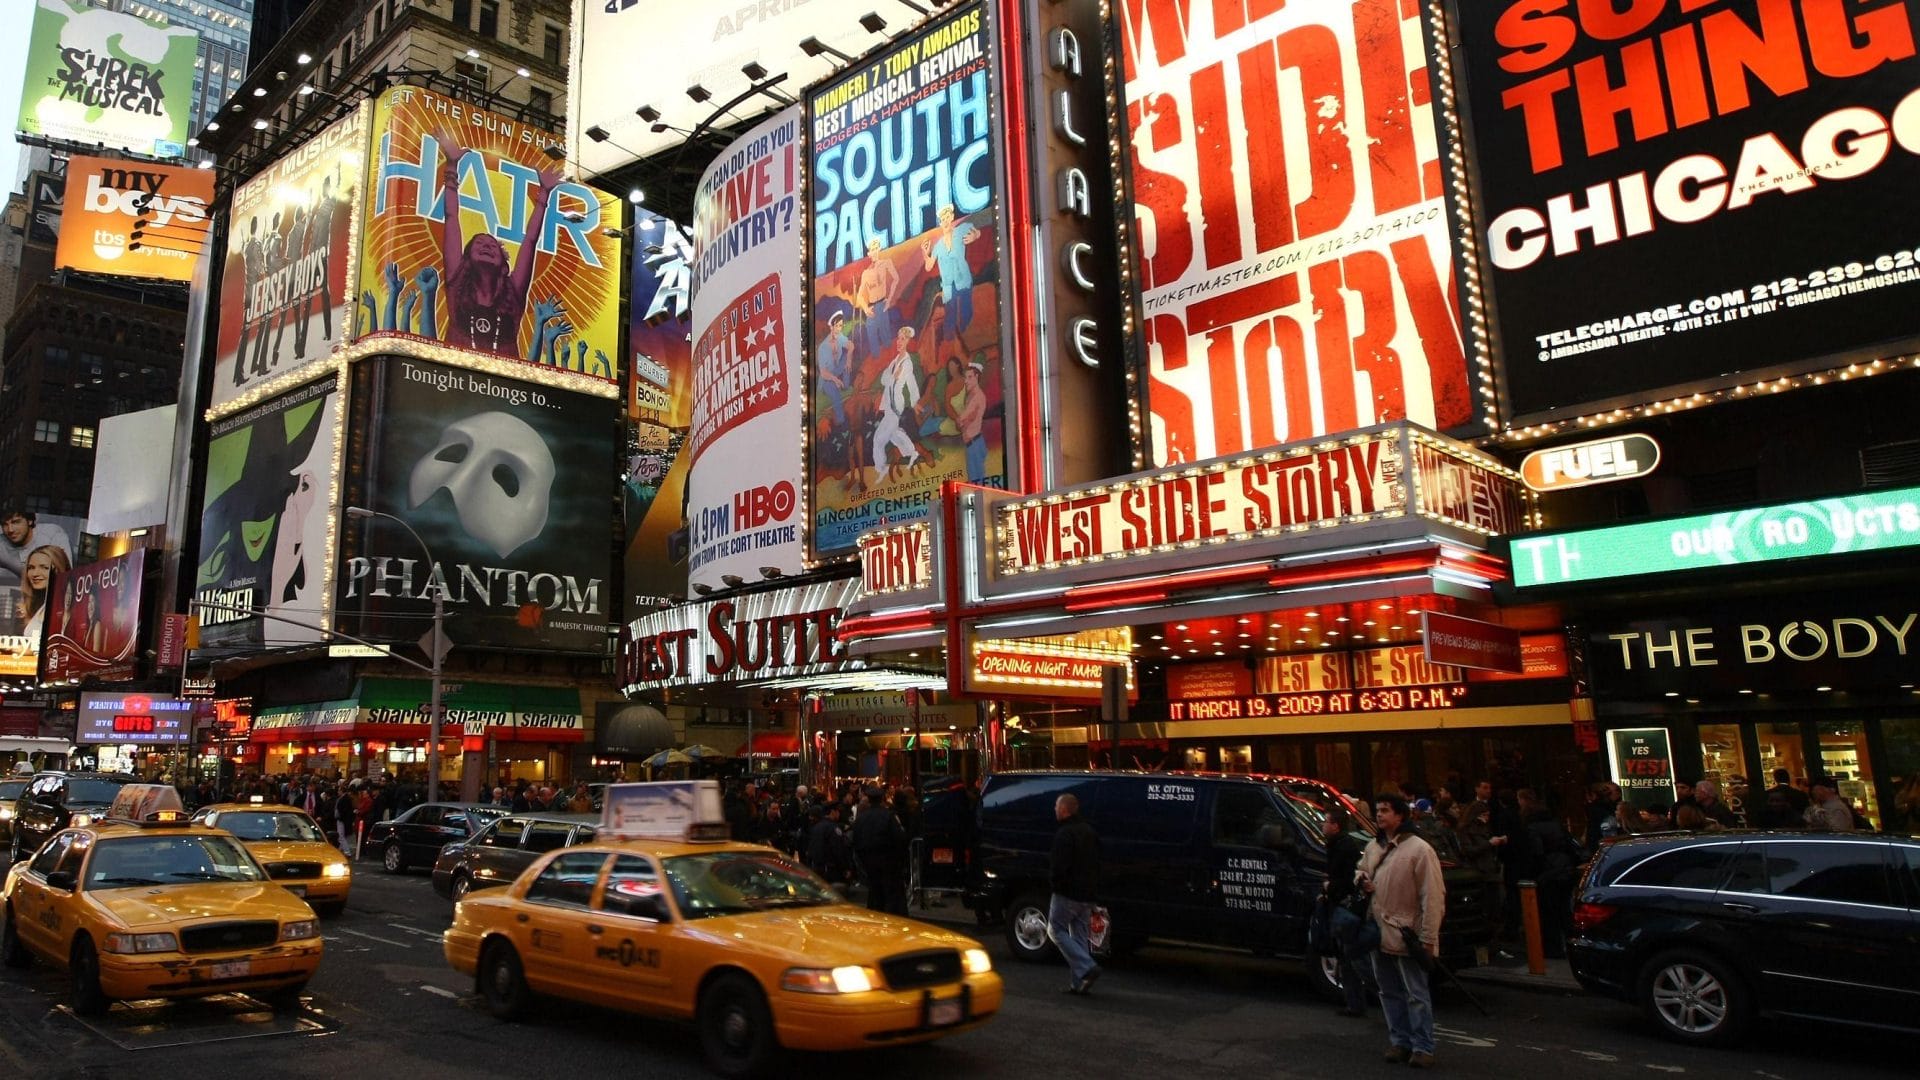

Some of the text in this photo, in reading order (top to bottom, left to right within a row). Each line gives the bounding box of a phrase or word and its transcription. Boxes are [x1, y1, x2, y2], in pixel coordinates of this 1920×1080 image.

[48, 77, 62, 88] THE
[57, 43, 165, 100] SHREK
[815, 9, 981, 119] WINNER! 7 TONY AWARDS
[59, 79, 163, 117] MUSICAL
[815, 34, 983, 142] BEST MUSICAL REVIVAL
[815, 58, 987, 153] RODGERS & HAMMERSTEIN'S
[1501, 0, 1917, 175] THING
[384, 89, 513, 138] LET THE SUN
[234, 112, 360, 209] BEST MUSICA
[713, 119, 794, 191] CAN DO FOR YOU
[816, 69, 989, 213] SOUTH
[100, 168, 169, 208] my
[710, 154, 773, 242] HAVE
[785, 143, 794, 194] I
[1738, 159, 1844, 194] THE MUSICAL
[84, 174, 207, 229] boys
[375, 131, 604, 269] HAIR
[815, 138, 991, 277] PACIFIC
[93, 229, 126, 246] tbs
[702, 196, 794, 282] COUNTRY?
[1145, 206, 1440, 312] TICKETMASTER.COM 212-307-4100
[246, 263, 293, 323] JERSEY
[293, 246, 327, 300] BOYS
[722, 284, 777, 337] EVENT
[1536, 288, 1746, 350] TELECHARGE.COM
[1551, 334, 1619, 361] AMBASSADOR
[1619, 325, 1666, 347] THEATRE
[1672, 316, 1703, 335] 49TH
[1704, 312, 1722, 327] ST.
[1724, 308, 1738, 324] AT
[1739, 300, 1778, 320] B'WAY
[401, 362, 465, 392] Tonight
[469, 375, 528, 406] belongs
[531, 391, 563, 411] to...
[638, 360, 668, 383] JOURNEY
[711, 344, 781, 414] AMERICA
[637, 386, 655, 404] BON
[724, 396, 745, 421] BUSH
[1539, 441, 1637, 484] FUEL
[851, 469, 963, 502] DIRECTED BY BARTLETT SHER
[1015, 441, 1381, 567] WEST SIDE STORY
[734, 480, 796, 533] HBO
[818, 491, 931, 527] LINCOLN CENTER
[701, 545, 717, 566] FROM
[718, 538, 730, 560] THE
[730, 533, 752, 556] CORT
[753, 524, 796, 550] THEATRE
[837, 523, 859, 536] TAKE
[1672, 526, 1735, 558] OUR
[76, 559, 120, 602] go red
[345, 556, 602, 617] PHANTOM
[635, 594, 655, 605] TEXT
[199, 587, 253, 627] WICKED
[555, 621, 607, 633] MAJESTIC THEATRE
[161, 616, 175, 663] BENVENUTO
[1609, 612, 1919, 669] THE BODY
[983, 656, 1032, 674] OPENING
[1035, 662, 1071, 677] NIGHT:
[1256, 655, 1313, 695] WEST
[1322, 650, 1385, 690] SIDE
[321, 707, 351, 723] sbarro
[367, 706, 431, 724] sbarro
[448, 708, 507, 726] sbarro
[855, 695, 884, 706] STAGE
[873, 712, 905, 727] GUEST
[1188, 700, 1240, 719] MARCH
[1246, 699, 1272, 716] 19,
[1278, 695, 1323, 715] 2009
[1329, 693, 1352, 713] AT
[1359, 690, 1402, 711] 6:30
[114, 717, 152, 731] GIFTS
[521, 713, 577, 729] sbarro
[1625, 760, 1668, 776] YES!
[1631, 746, 1649, 755] YES
[1163, 785, 1181, 793] CITY
[1620, 778, 1671, 787] TO SAFE SEX
[1241, 859, 1268, 870] RENTALS
[1247, 873, 1255, 883] 23
[1256, 874, 1276, 885] SOUTH
[1253, 887, 1274, 899] 07470
